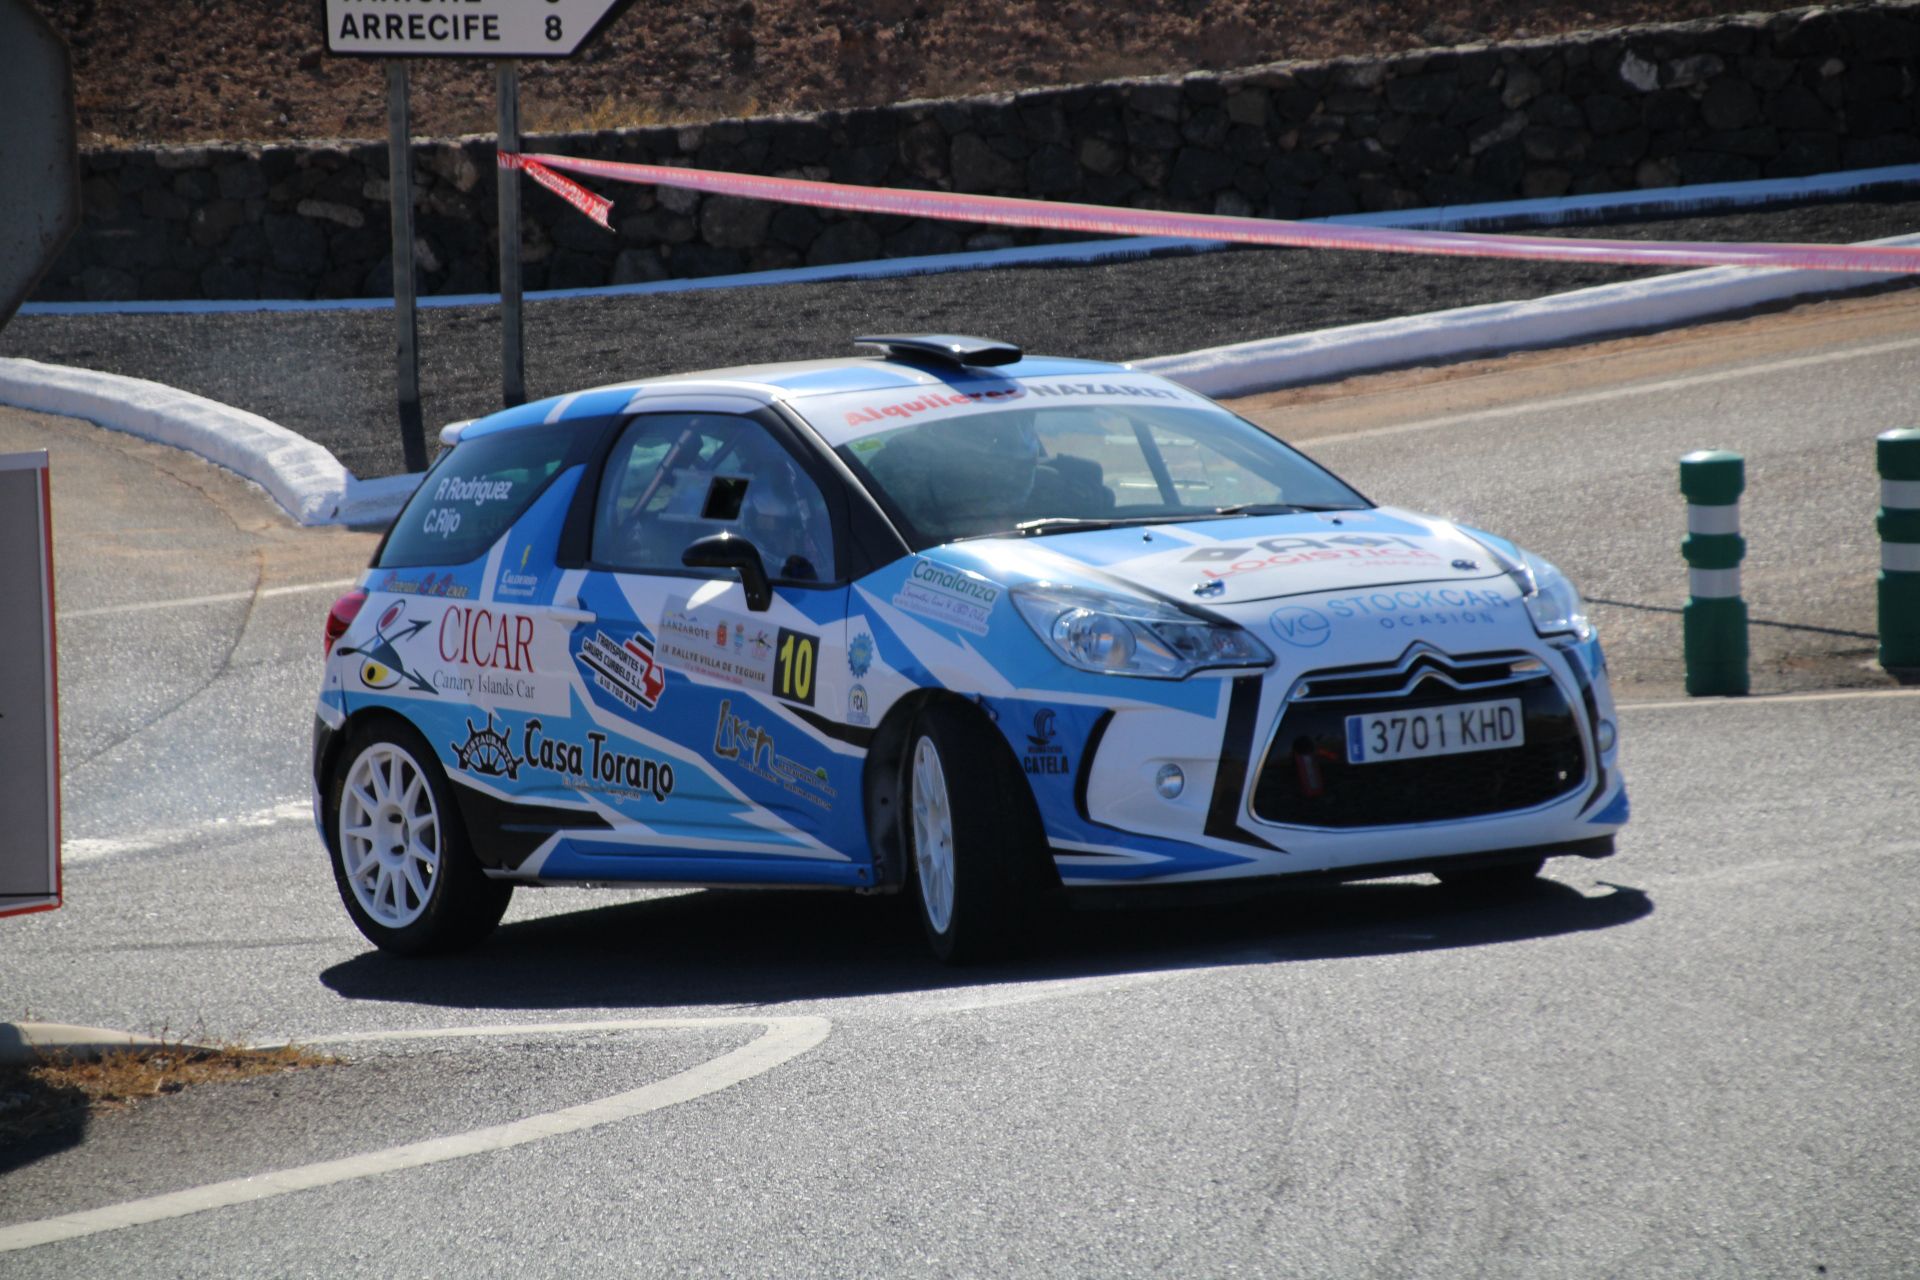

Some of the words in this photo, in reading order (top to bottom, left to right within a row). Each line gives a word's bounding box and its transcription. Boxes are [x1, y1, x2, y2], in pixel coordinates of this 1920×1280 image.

[340, 13, 501, 41] ARRECIFE
[545, 14, 563, 41] 8
[913, 560, 998, 603] Canalanza
[1328, 588, 1511, 618] STOCKCAR
[438, 604, 535, 673] CICAR
[661, 618, 710, 640] LANZAROTE
[597, 631, 640, 671] TRANSPORTES
[671, 646, 698, 662] RALLYE
[699, 655, 721, 668] VILLA
[722, 661, 732, 672] DE
[735, 665, 766, 682] TEGUISE
[780, 634, 813, 699] 10
[432, 670, 475, 696] Canary
[478, 673, 514, 697] Islands
[516, 679, 536, 699] Car
[1371, 713, 1446, 754] 3701
[1459, 706, 1516, 745] KHD
[524, 719, 583, 776] Casa
[588, 732, 674, 802] Torano
[1023, 755, 1070, 775] CATELA
